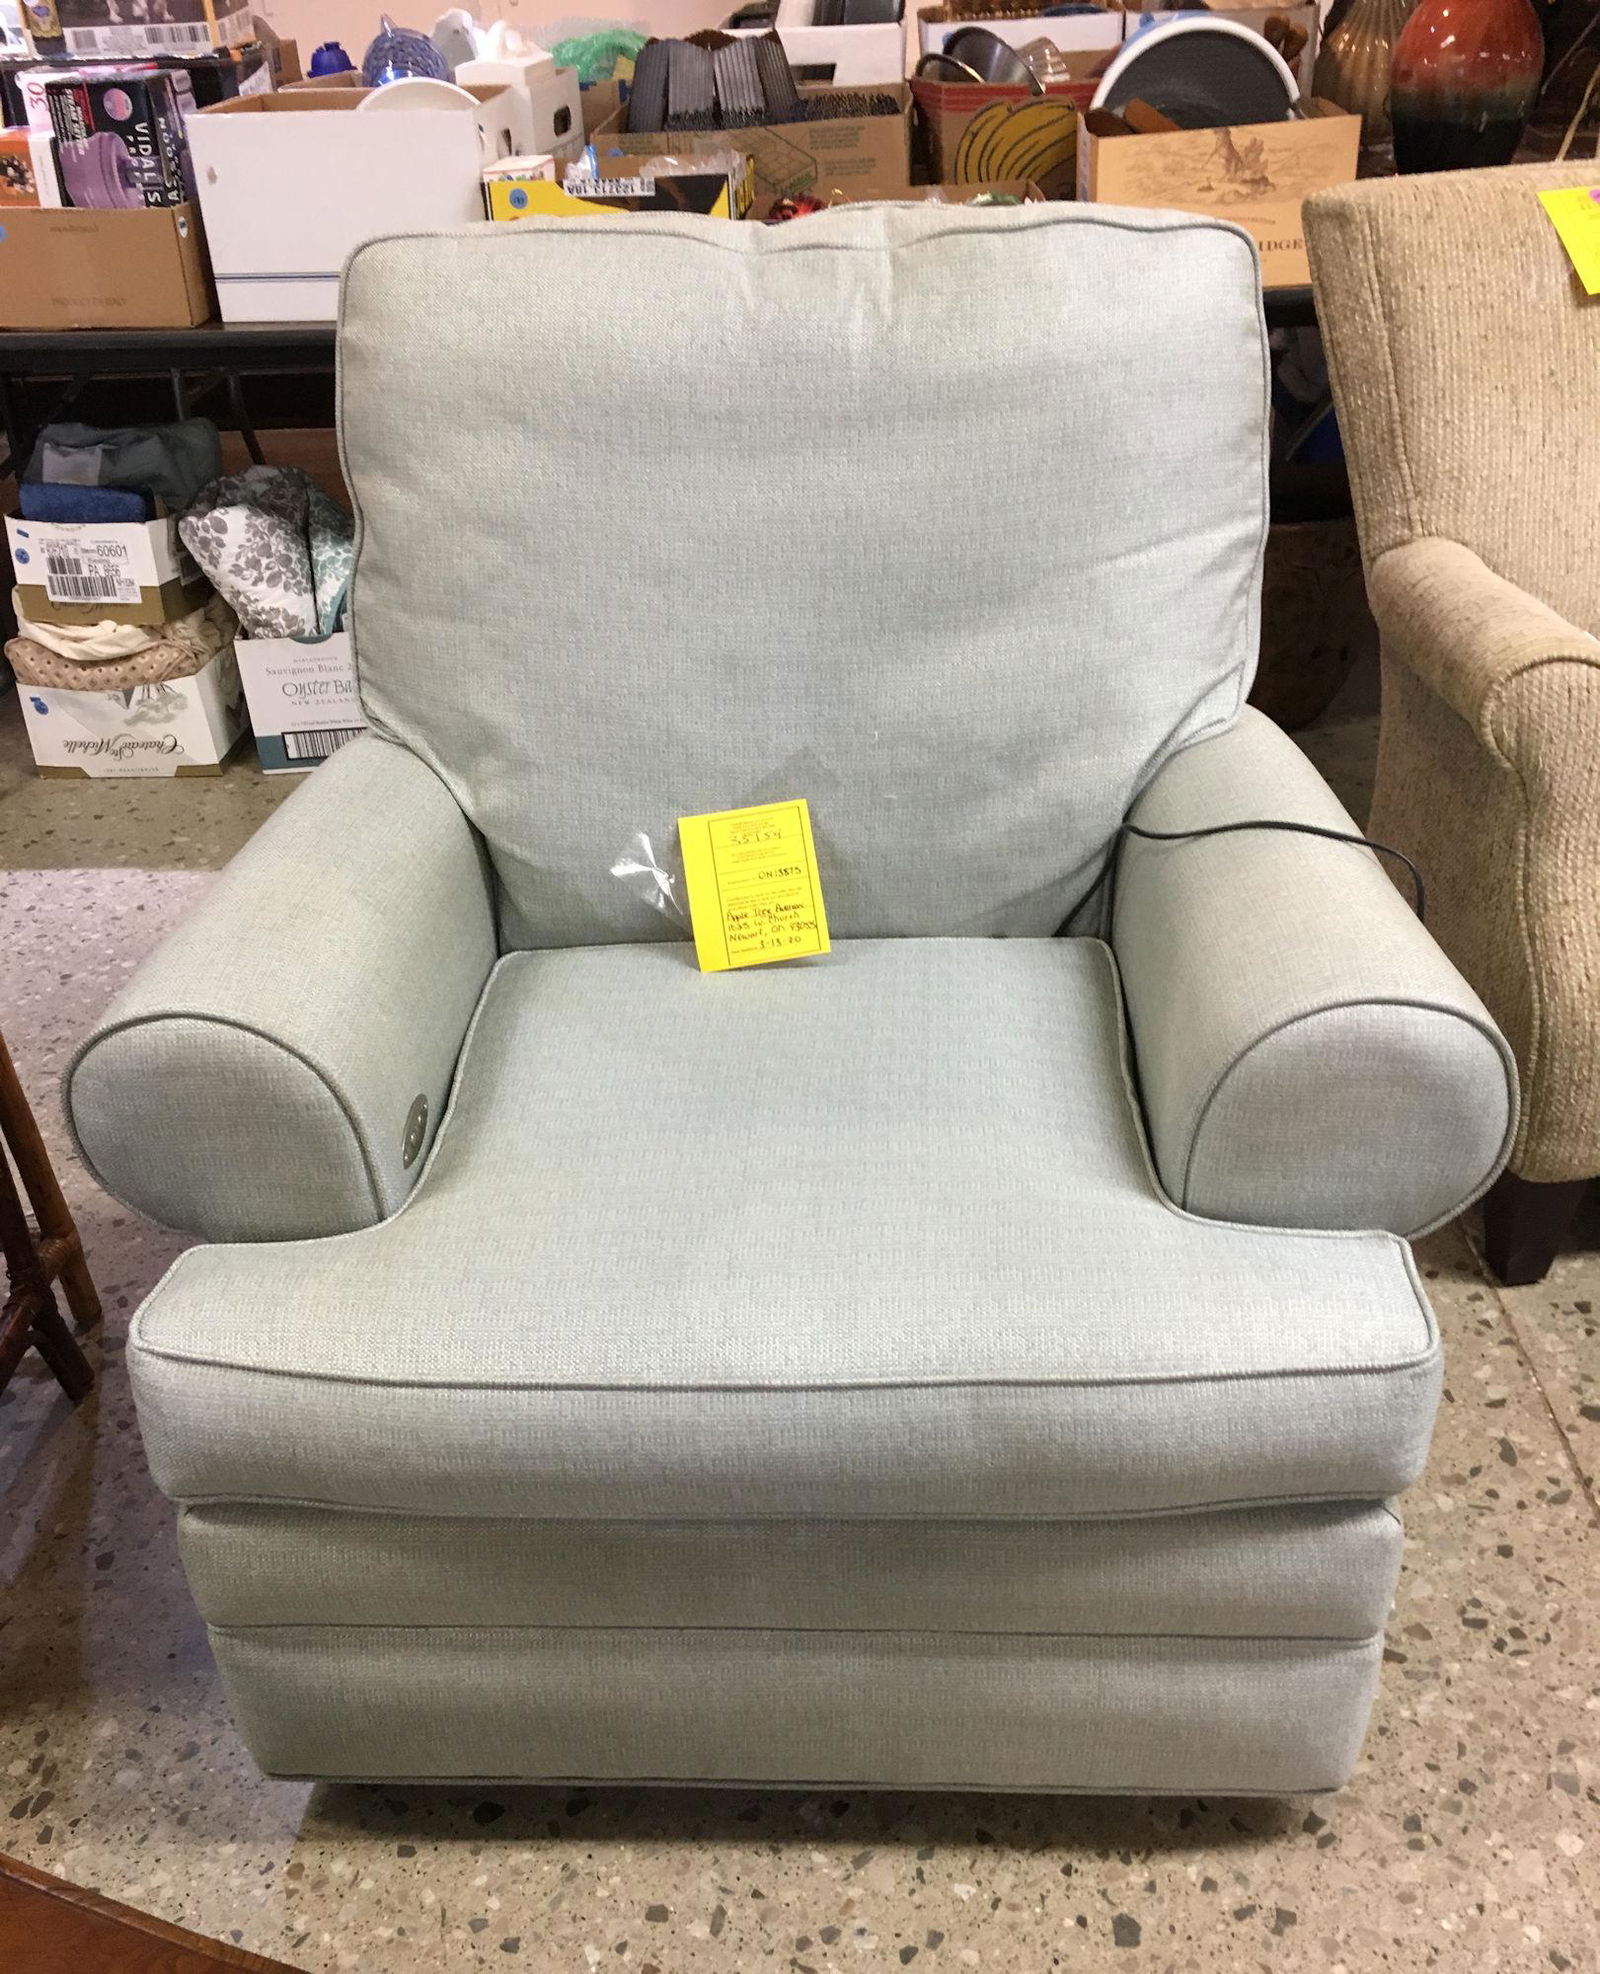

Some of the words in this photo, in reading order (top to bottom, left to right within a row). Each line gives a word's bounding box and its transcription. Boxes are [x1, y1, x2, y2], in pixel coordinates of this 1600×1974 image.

[135, 122, 158, 181] VIDAL
[147, 190, 162, 204] S
[1259, 239, 1303, 251] IDGE
[96, 544, 128, 557] 60601
[88, 564, 99, 576] PA
[265, 663, 315, 676] Sauvignon
[318, 663, 344, 673] Blanc
[282, 679, 330, 699] Oyster
[333, 679, 353, 694] Ba
[315, 697, 351, 705] ZEALAN
[63, 736, 115, 756] Michelle
[121, 734, 184, 755] Chateau
[110, 747, 134, 761] Ste
